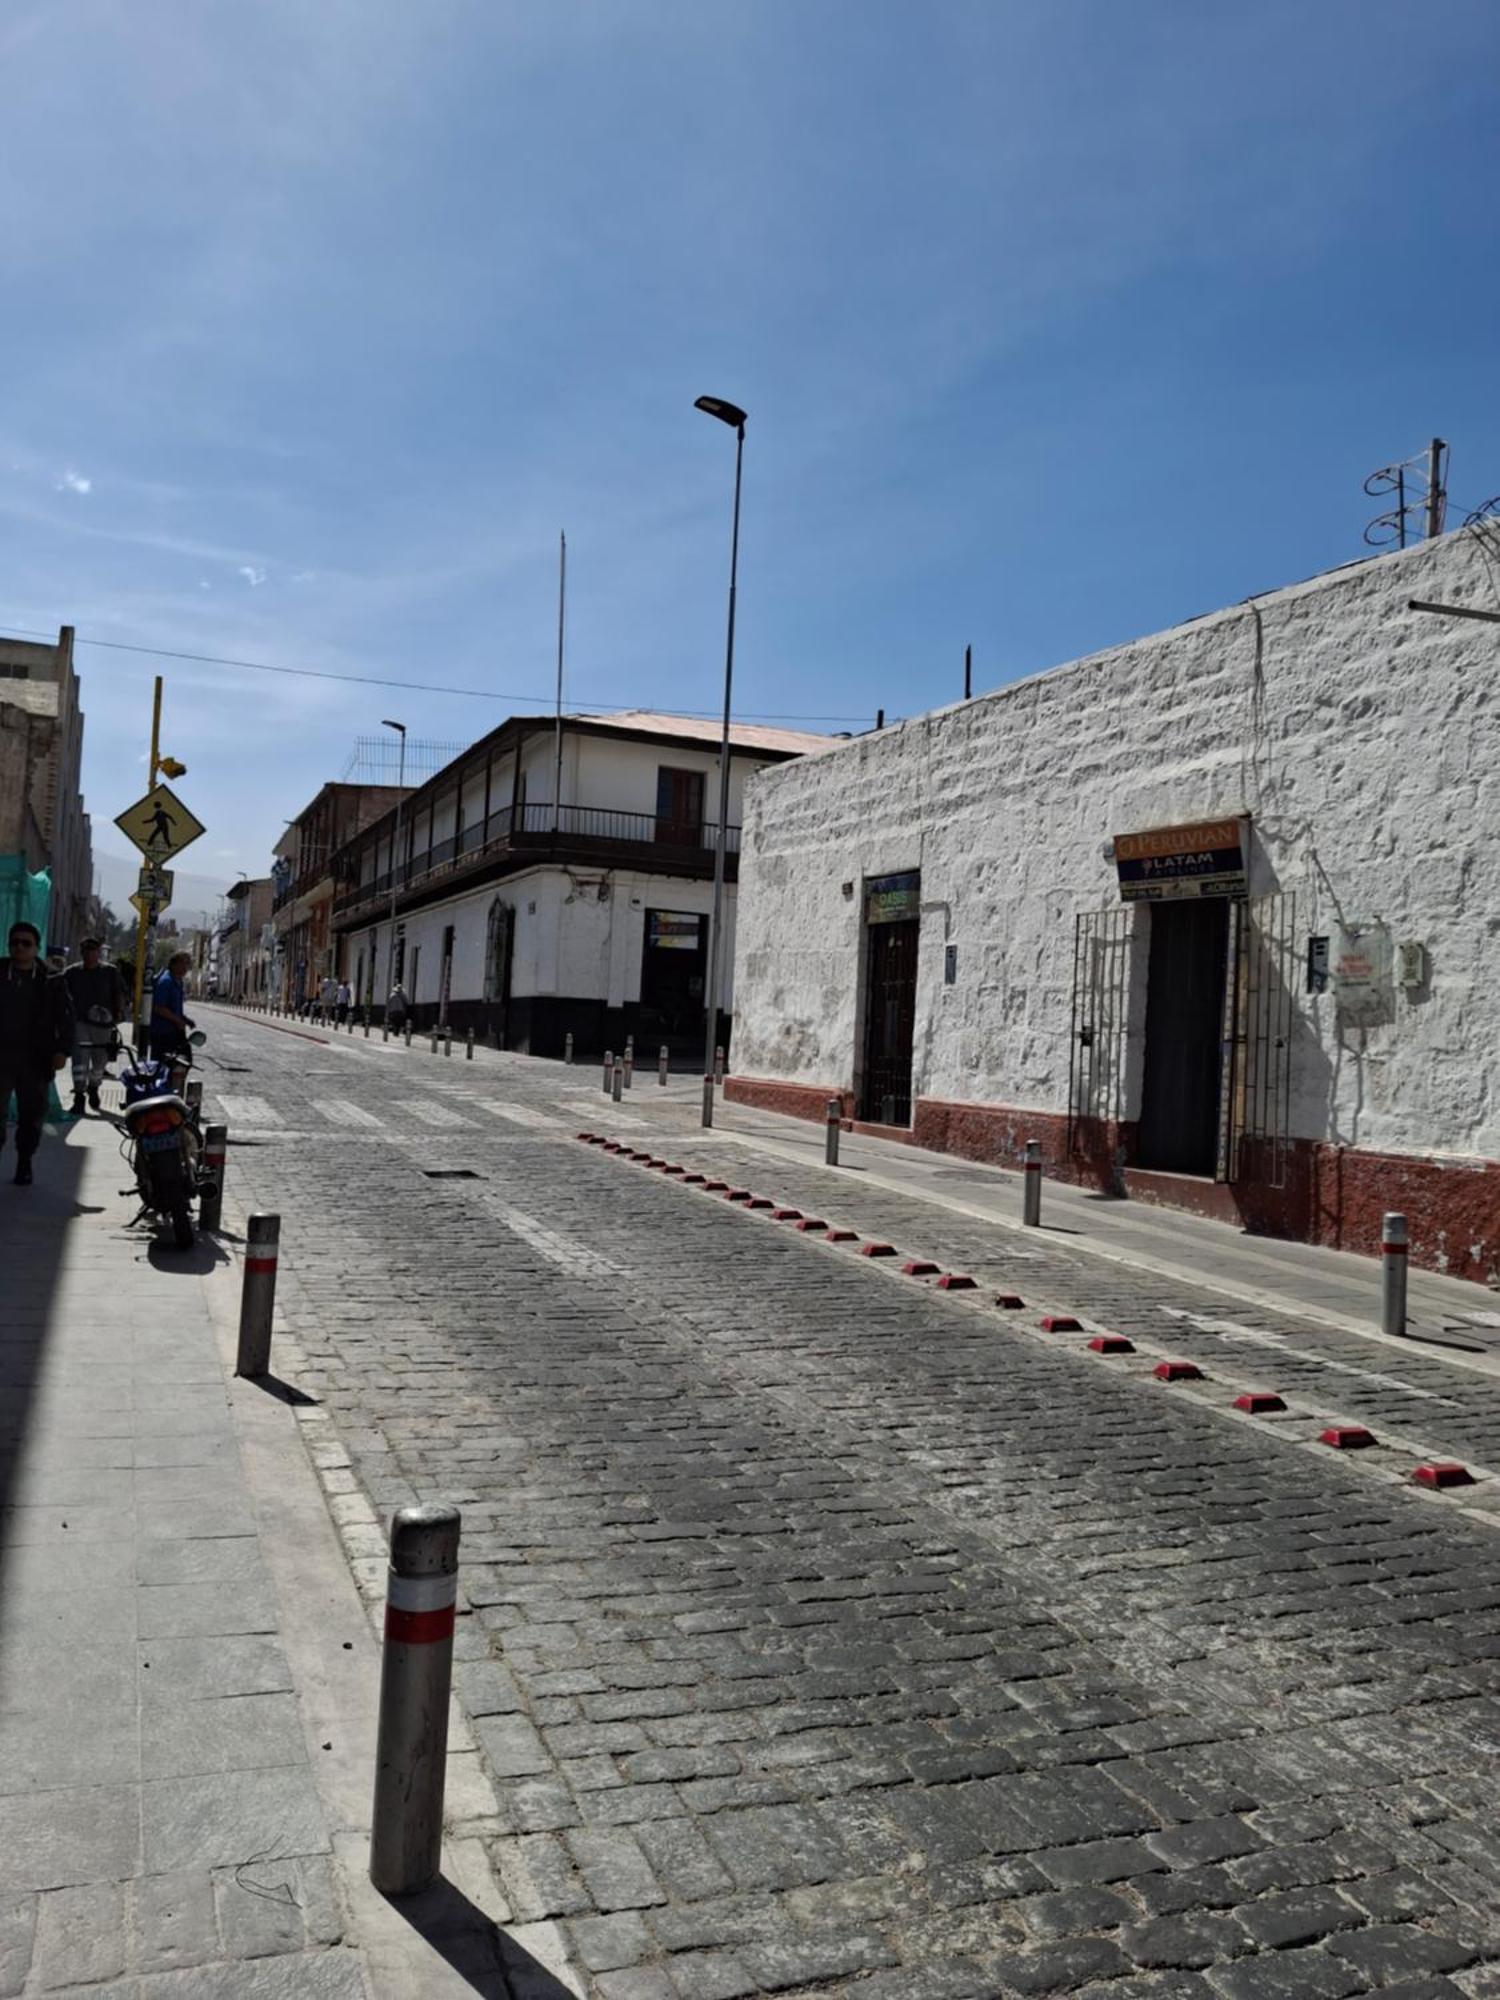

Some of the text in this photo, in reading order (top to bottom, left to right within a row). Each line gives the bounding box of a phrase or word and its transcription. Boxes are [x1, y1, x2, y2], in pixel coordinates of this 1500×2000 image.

[1138, 827, 1232, 851] PERUVIAN
[1153, 853, 1214, 868] LATAM
[1153, 865, 1216, 876] AIRLINES
